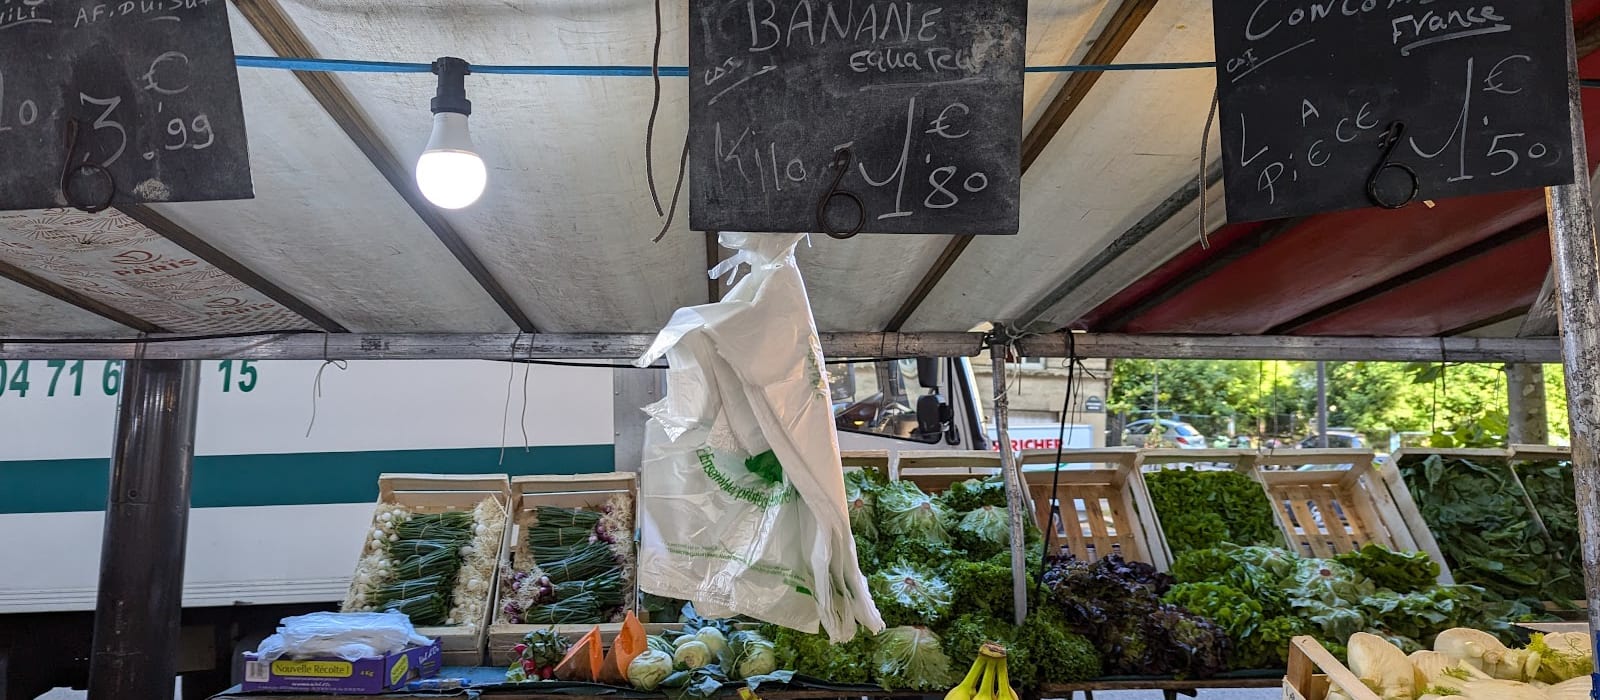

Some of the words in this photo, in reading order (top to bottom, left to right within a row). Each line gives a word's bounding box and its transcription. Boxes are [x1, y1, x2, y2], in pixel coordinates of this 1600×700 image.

[748, 0, 943, 51] BANANE
[1391, 6, 1505, 45] France
[46, 359, 85, 397] 71
[217, 359, 259, 393] 15
[275, 664, 312, 675] Nouvelle
